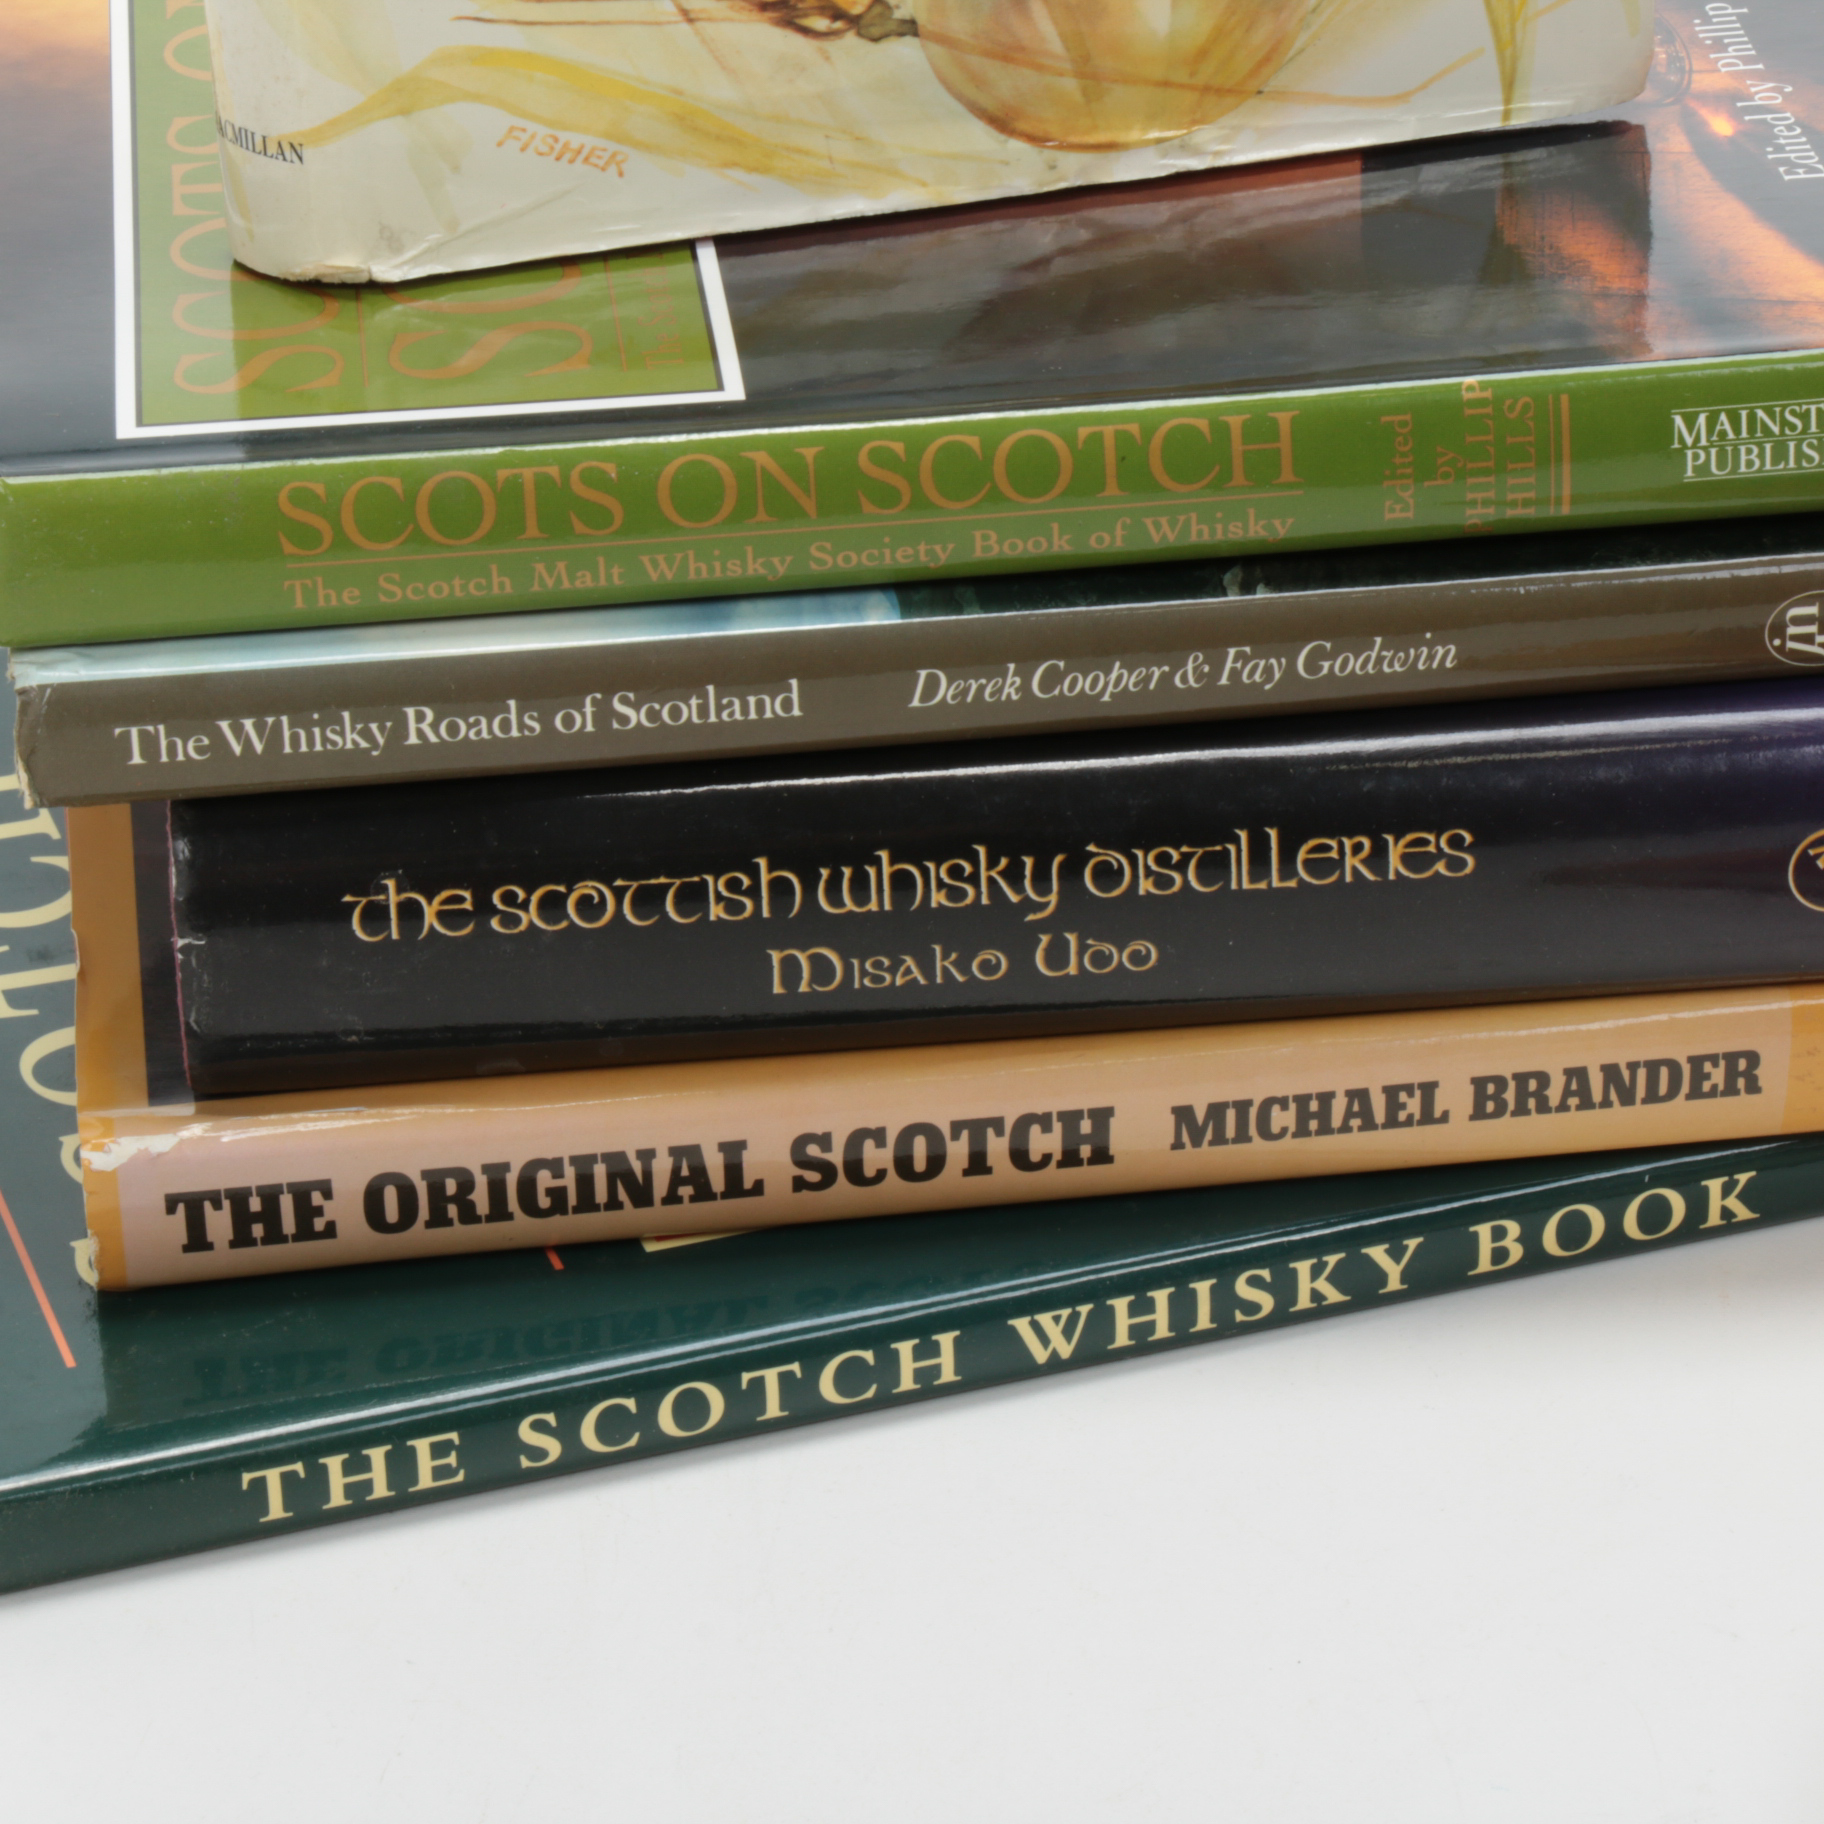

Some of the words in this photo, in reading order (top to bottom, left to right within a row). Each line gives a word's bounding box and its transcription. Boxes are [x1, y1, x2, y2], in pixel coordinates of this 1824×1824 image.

[1693, 3, 1765, 73] Phillip
[1736, 80, 1793, 107] by
[215, 115, 304, 165] ACMILLAN
[496, 125, 630, 178] FISHER
[1744, 112, 1824, 181] Edited
[278, 461, 624, 556] SCOTS
[657, 446, 825, 529] ON
[857, 410, 1304, 515] SCOTCH
[1380, 411, 1415, 521] Edited
[1423, 445, 1465, 488] by
[1461, 379, 1495, 534] PHILLIP
[1504, 396, 1536, 517] HILLS
[1684, 437, 1824, 477] PUBLIS
[284, 576, 361, 609] The
[377, 563, 513, 602] Scotch
[529, 555, 625, 593] Malt
[639, 546, 794, 581] Whisky
[808, 536, 956, 571] Society
[972, 522, 1074, 558] Book
[1089, 517, 1131, 554] of
[1141, 508, 1295, 543] Whisky
[908, 662, 1022, 708] Derek
[1032, 658, 1169, 702] Cooper
[1174, 651, 1210, 689] &
[1217, 646, 1287, 690] Fay
[1297, 631, 1458, 670] Godwin
[114, 723, 211, 766] The
[215, 709, 393, 756] Whisky
[403, 699, 541, 746] Roads
[554, 692, 602, 734] of
[612, 678, 804, 731] Scotland
[165, 1178, 338, 1254] THE
[363, 1140, 764, 1235] ORIGINAL
[790, 1106, 1115, 1194] SCOTCH
[1170, 1081, 1450, 1151] MICHAEL
[1469, 1049, 1763, 1122] BRANDER
[242, 1431, 466, 1522] THE
[518, 1330, 962, 1468] SCOTCH
[1008, 1237, 1424, 1366] WHISKY
[1468, 1170, 1761, 1276] BOOK
